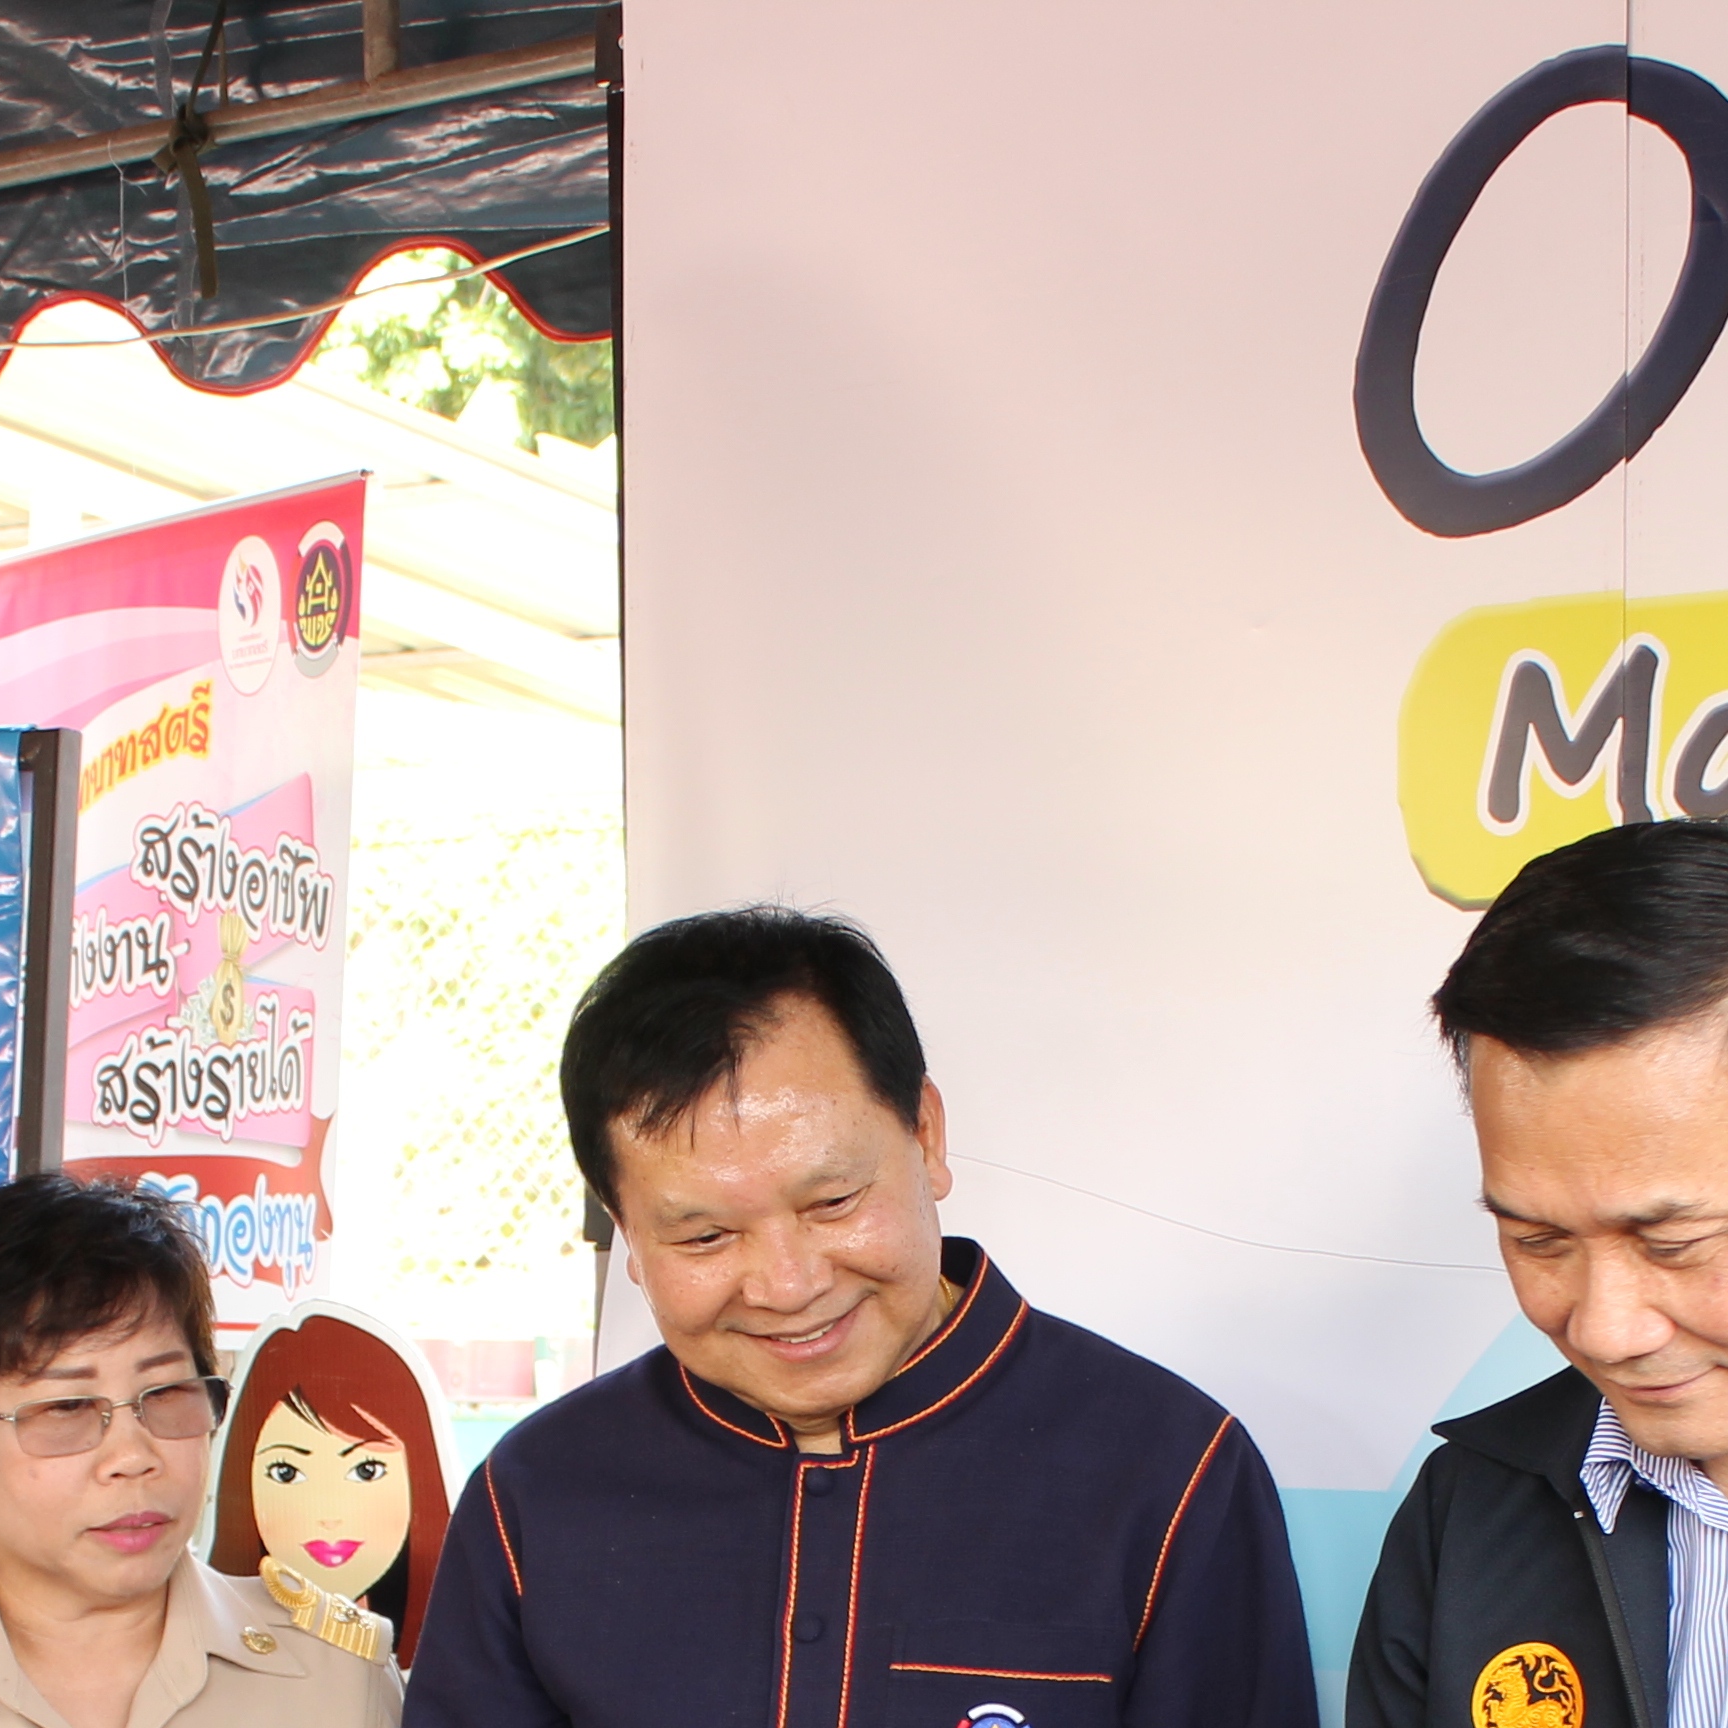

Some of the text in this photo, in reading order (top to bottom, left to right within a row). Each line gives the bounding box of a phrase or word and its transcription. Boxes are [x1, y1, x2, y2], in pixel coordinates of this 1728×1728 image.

[137, 811, 330, 939] สร้างอาชีพ
[97, 1001, 310, 1135] สร้างรายได้
[177, 1180, 313, 1290] กองทุน
